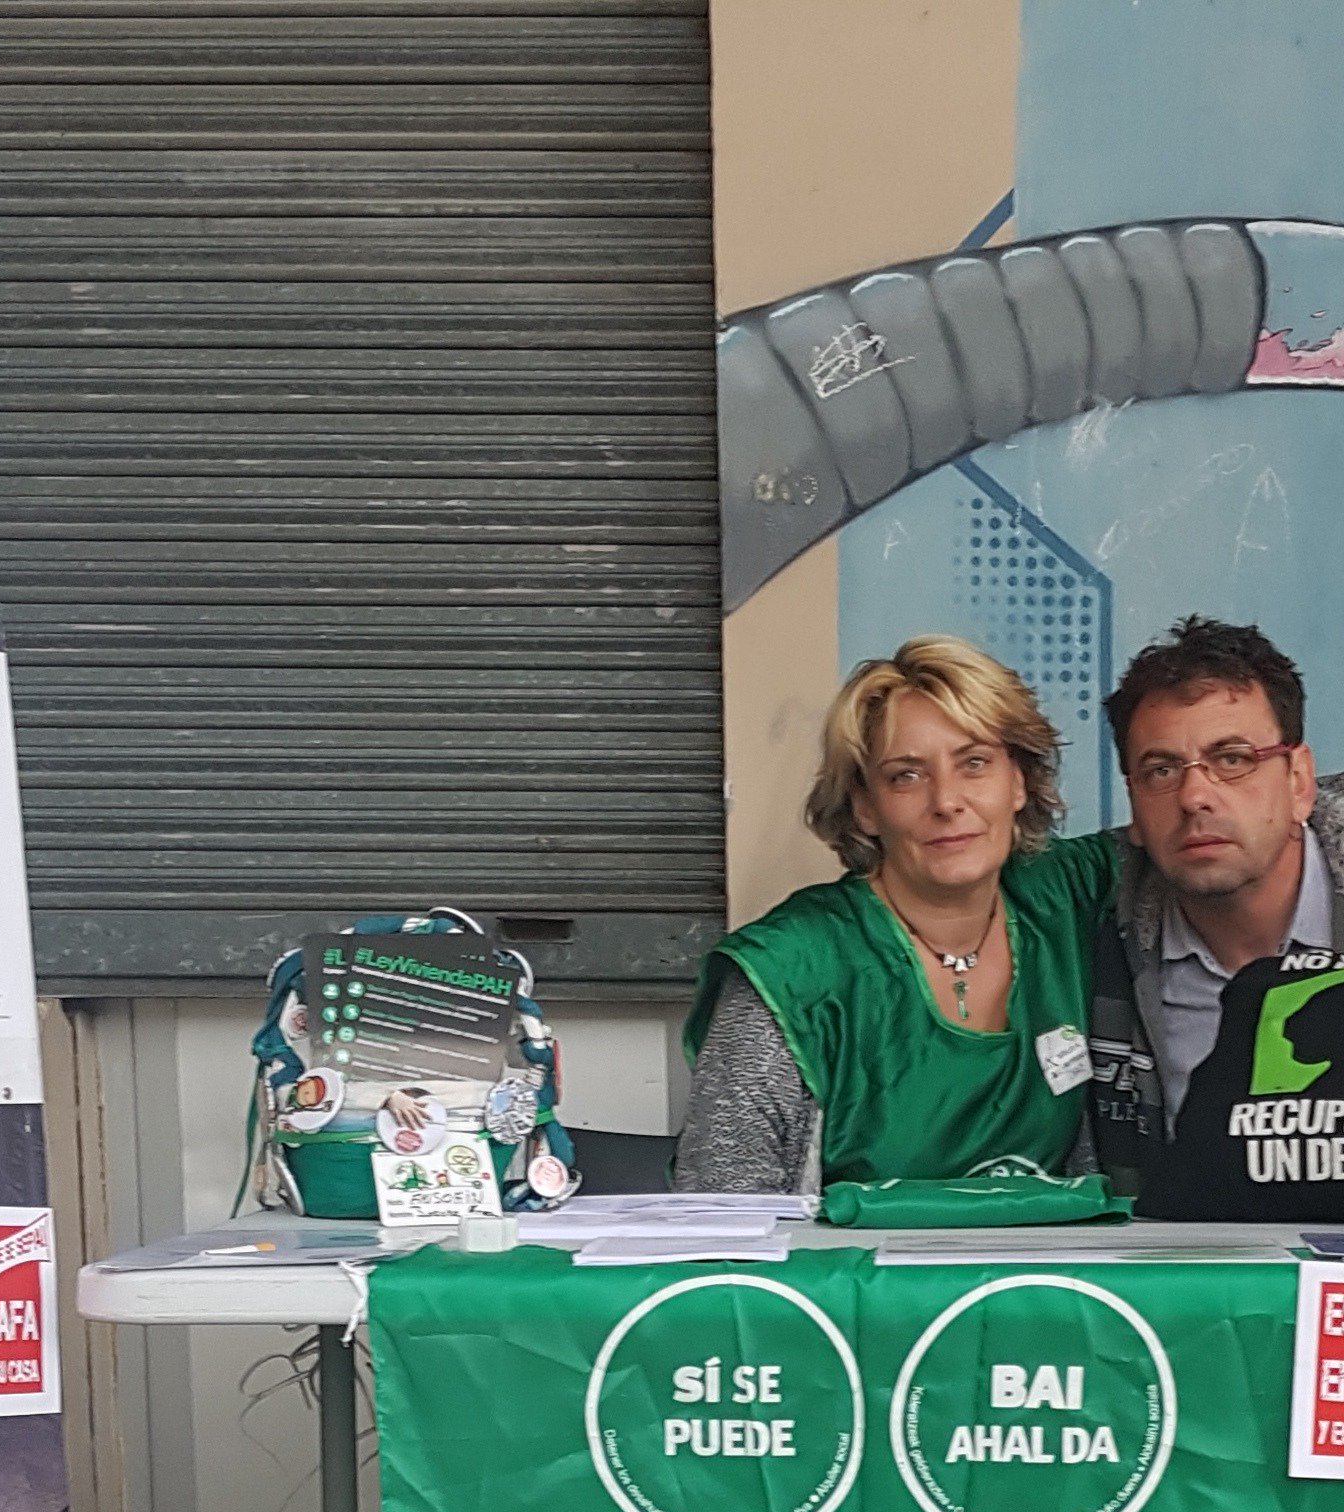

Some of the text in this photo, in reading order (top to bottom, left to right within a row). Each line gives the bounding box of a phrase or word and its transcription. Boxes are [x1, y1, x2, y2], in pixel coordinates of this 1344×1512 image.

[355, 947, 513, 997] #LeyViviendaPAH
[1246, 1137, 1302, 1183] UN
[8, 1359, 40, 1383] CASA
[673, 1357, 783, 1405] SÍ SE
[990, 1364, 1084, 1411] BAI
[664, 1418, 797, 1458] PUEDE
[945, 1425, 1120, 1464] AHAL DA
[1316, 1420, 1330, 1445] Y
